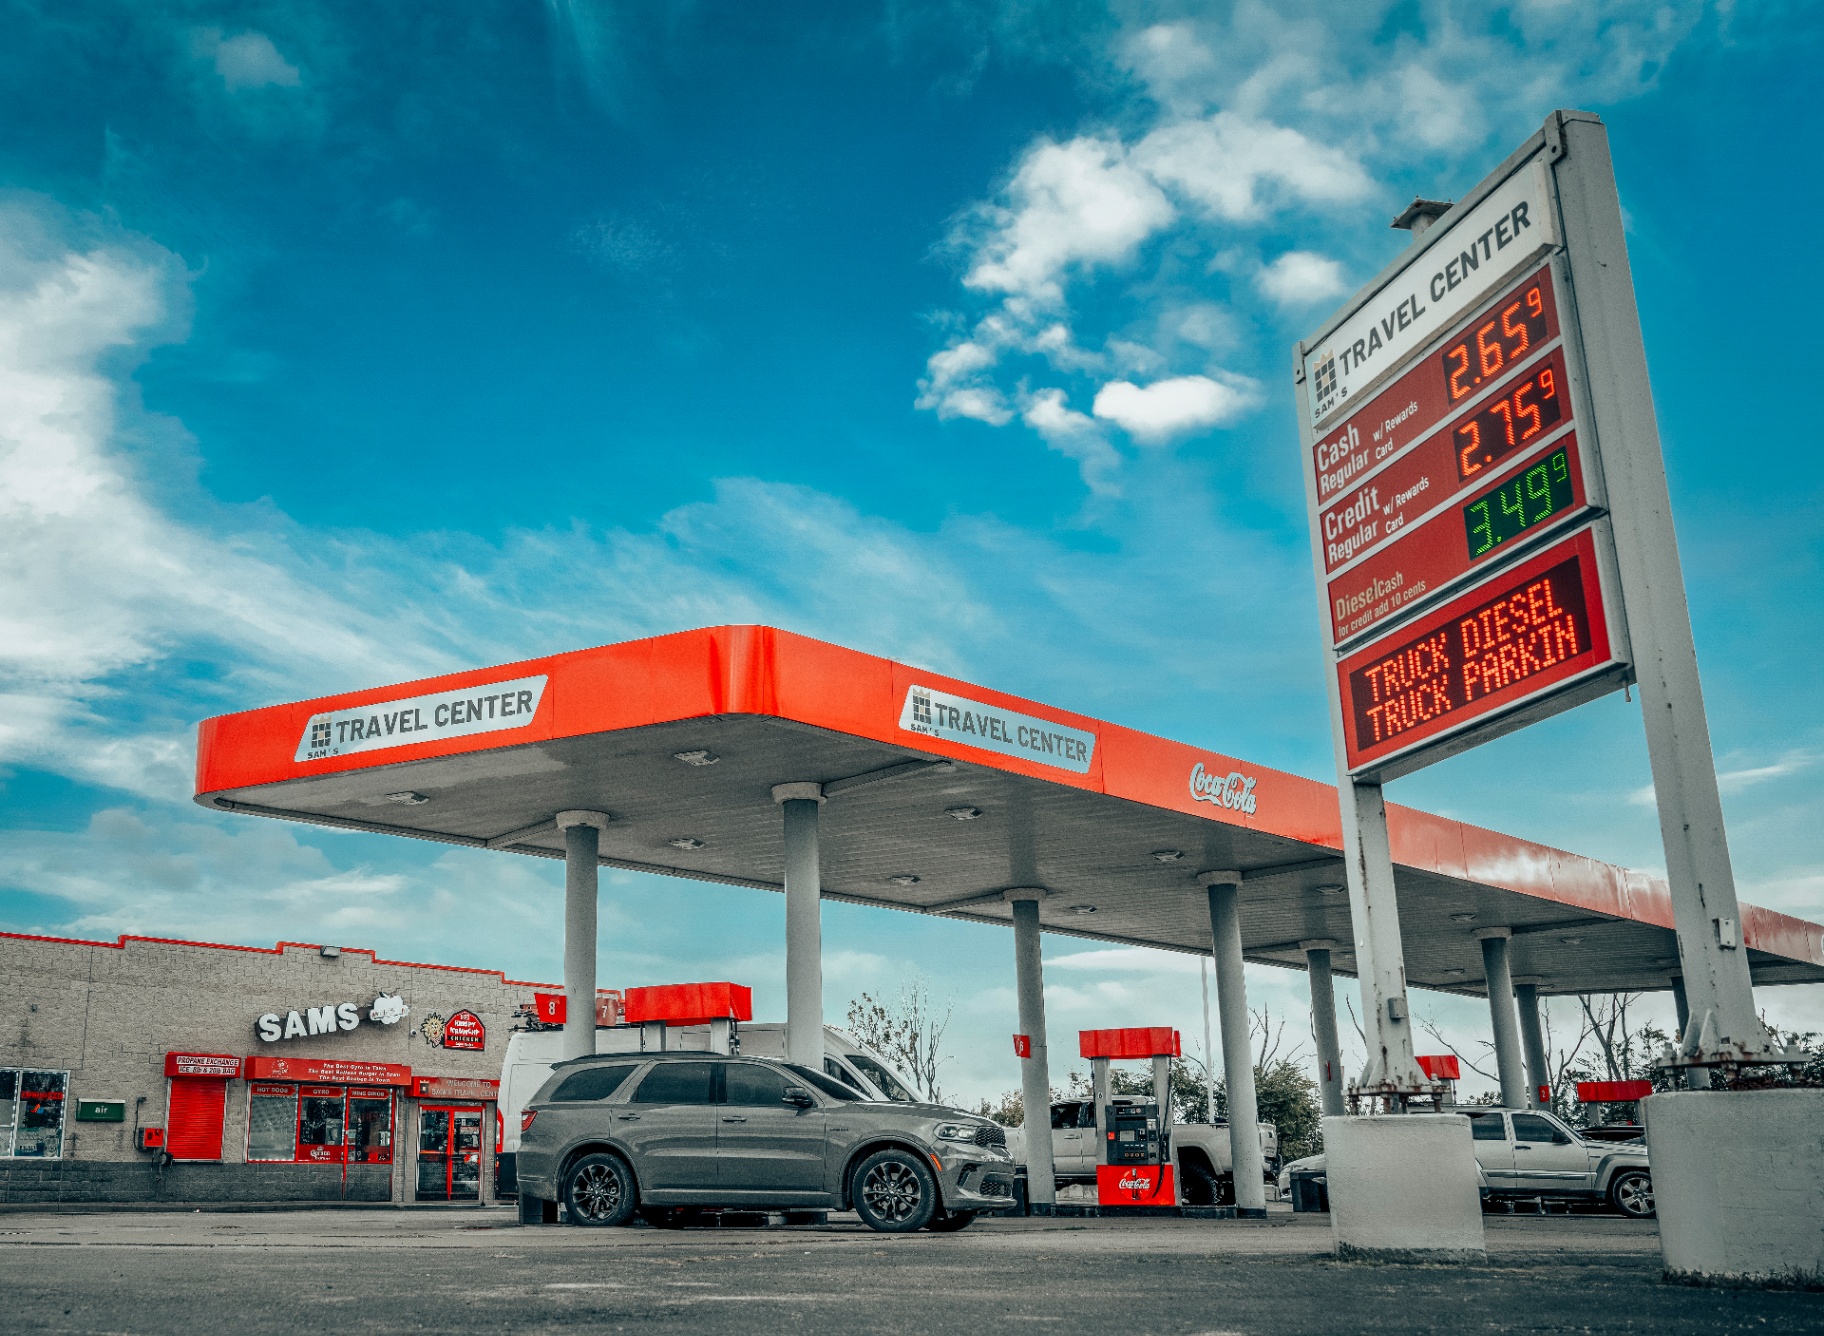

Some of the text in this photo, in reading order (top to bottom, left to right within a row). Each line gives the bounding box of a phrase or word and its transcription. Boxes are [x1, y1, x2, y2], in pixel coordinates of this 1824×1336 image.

[1339, 200, 1531, 376] TRAVEL CENTER
[1314, 386, 1348, 419] SAM'S
[1385, 400, 1418, 433] Rewards
[1317, 423, 1360, 472] Cash
[1375, 437, 1394, 460] Card
[1320, 448, 1370, 496] Regular
[1395, 476, 1430, 508] Rewards
[1325, 485, 1380, 541] Credit
[1385, 511, 1404, 534] Card
[1328, 520, 1378, 565] Regular
[1338, 580, 1427, 638] for credit add 10 cents
[1364, 578, 1563, 702] TRUCK DIESEL
[1366, 614, 1578, 742] TRUCK PARKIN
[335, 690, 533, 744] TRAVEL CENTER
[910, 723, 940, 737] SAM'S
[934, 702, 1088, 763] TRAVEL CENTER
[307, 747, 339, 760] SAM'S
[258, 1002, 360, 1042] SAMS
[549, 1001, 555, 1015] 8
[602, 1006, 608, 1018] 7
[177, 1056, 239, 1066] PROPANE EXCHANGE
[447, 1080, 491, 1089] WELCOME TO
[94, 1105, 108, 1114] air
